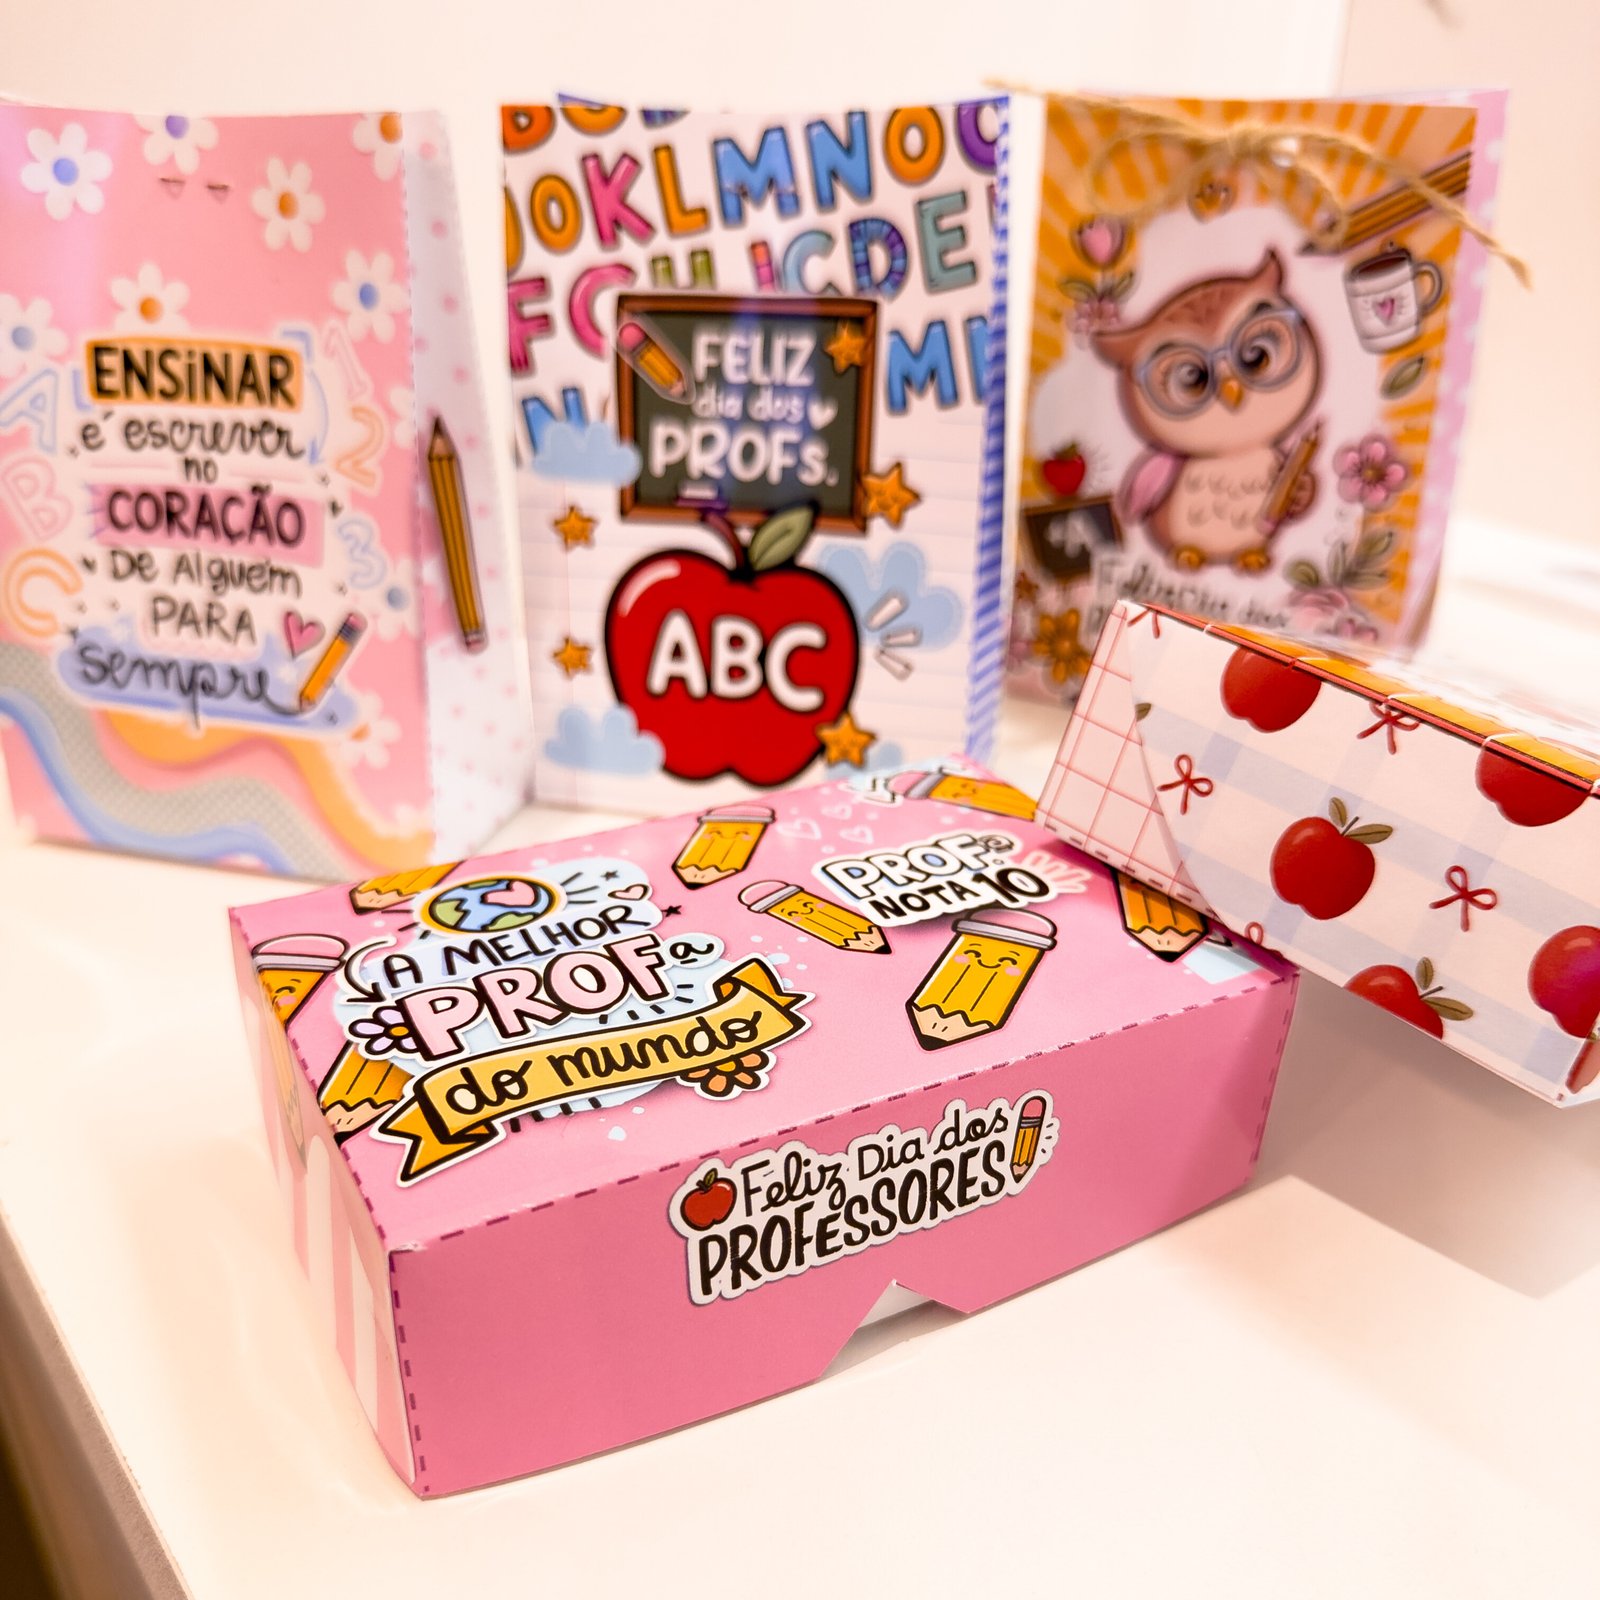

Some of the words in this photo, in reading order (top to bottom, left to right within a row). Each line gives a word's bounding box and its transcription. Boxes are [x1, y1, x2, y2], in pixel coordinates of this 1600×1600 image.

[693, 325, 818, 387] FELIZ
[124, 417, 304, 458] escrever
[748, 387, 806, 424] dos
[182, 456, 218, 484] no
[107, 484, 305, 548] CORAÇÃO
[151, 595, 257, 645] PARA
[78, 643, 305, 730] sempre
[647, 608, 828, 711] ABC
[868, 880, 980, 919] NOTA
[972, 867, 1050, 903] 10
[384, 953, 422, 988] A
[442, 904, 650, 976] MELHOR
[447, 1059, 533, 1116] do
[550, 1010, 763, 1088] mundo
[740, 1150, 848, 1218] Feliz
[857, 1135, 925, 1181] Dia
[933, 1108, 1009, 1155] dos
[699, 1140, 1008, 1297] PROFESSORES
